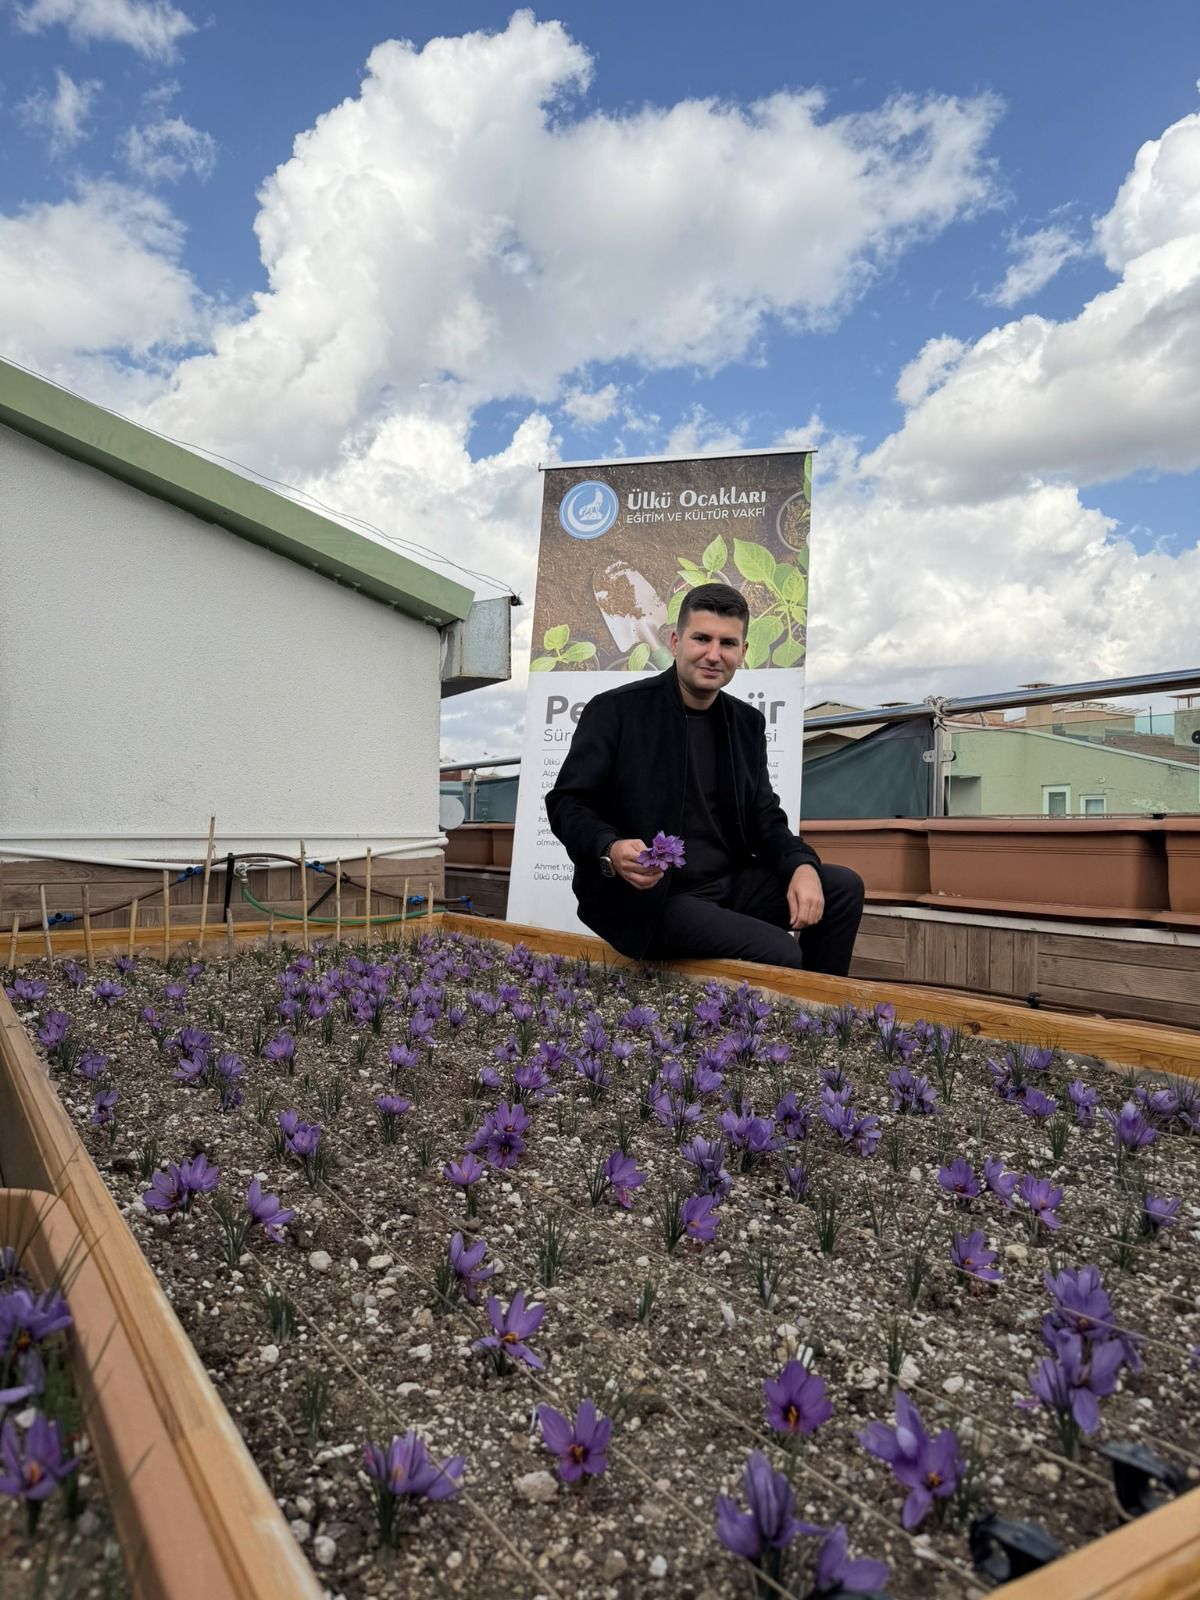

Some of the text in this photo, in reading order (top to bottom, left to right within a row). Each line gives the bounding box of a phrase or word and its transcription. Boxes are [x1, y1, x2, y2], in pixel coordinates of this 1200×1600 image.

[626, 507, 766, 524] EĞİTİM VE KÜLTÜR VAKFI
[534, 863, 560, 871] Ahmet
[533, 871, 550, 881] Ülkü
